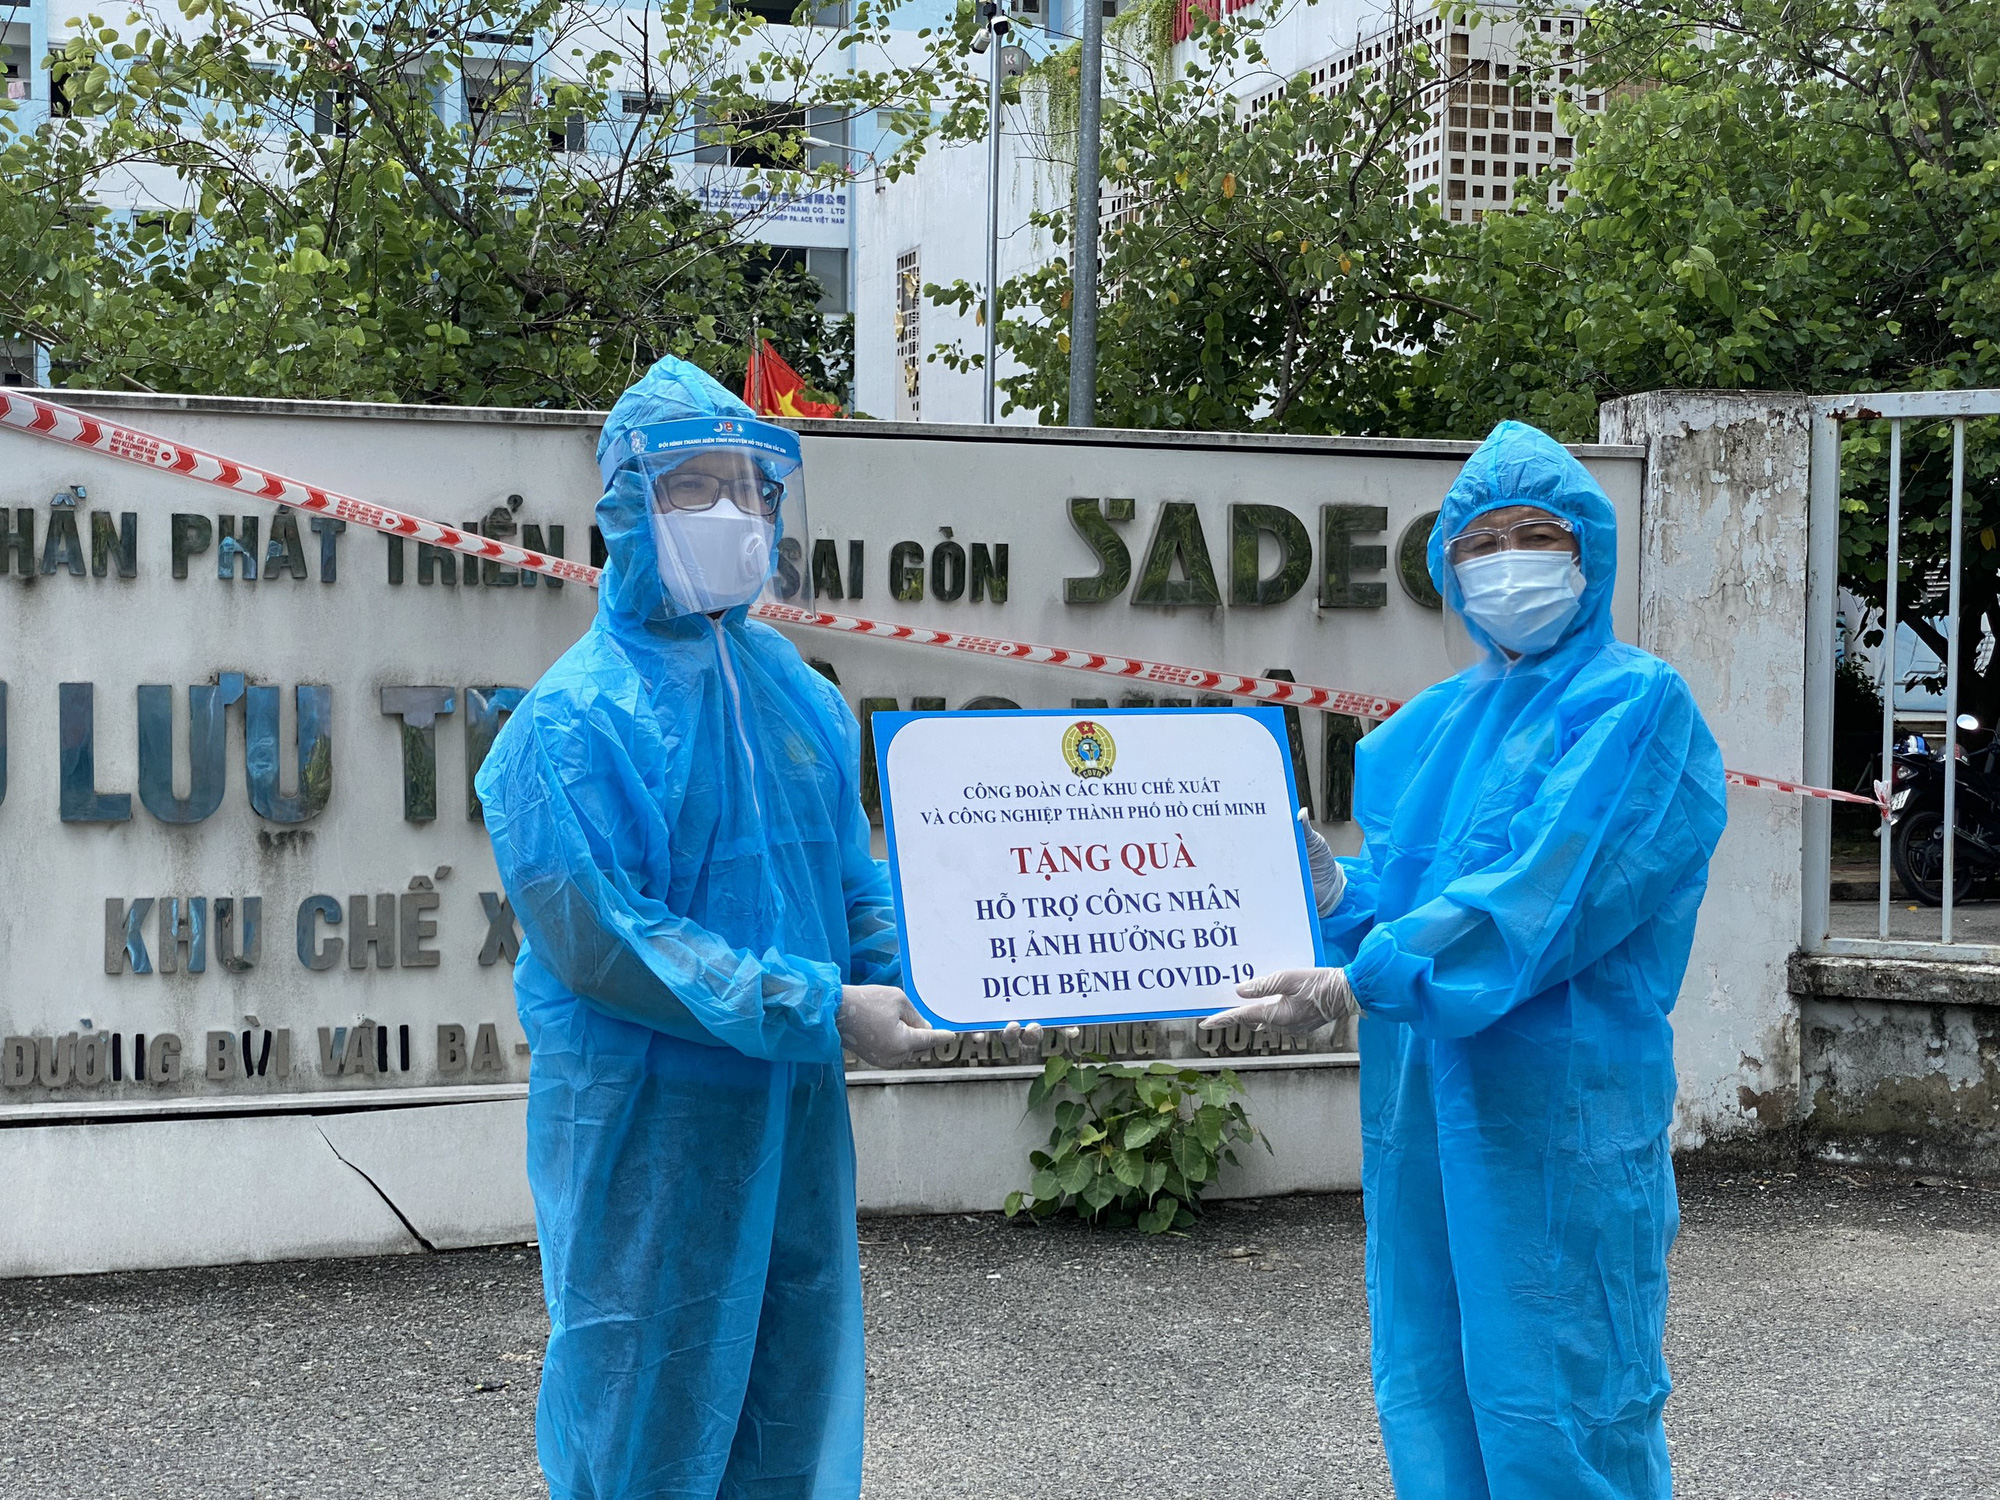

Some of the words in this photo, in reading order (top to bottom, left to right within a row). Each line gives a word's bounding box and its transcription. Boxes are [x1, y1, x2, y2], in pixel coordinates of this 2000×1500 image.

[171, 503, 347, 583] PHÁT
[889, 526, 1010, 603] GÒN
[59, 672, 332, 824] LƯU
[963, 782, 1011, 799] CÔNG
[1015, 781, 1061, 798] ĐOÀN
[1065, 780, 1099, 797] CÁC
[1103, 782, 1137, 796] KHU
[1142, 778, 1175, 794] CHẾ
[1179, 777, 1221, 794] XUẤT
[920, 808, 945, 825] VÀ
[948, 807, 996, 825] CÔNG
[1000, 806, 1063, 824] NGHIỆP
[1066, 804, 1124, 821] THÀNH
[1128, 802, 1161, 819] PHỐ
[1165, 800, 1188, 817] HỒ
[1192, 800, 1221, 816] CHÍ
[1224, 802, 1266, 816] MINH
[1010, 841, 1111, 881] TẶNG
[1120, 833, 1197, 876] QUÀ
[105, 897, 262, 974] KHU
[297, 865, 452, 971] CHẾ
[975, 892, 1016, 920] HỖ
[1022, 893, 1078, 922] TRỢ
[1085, 887, 1162, 916] CÔNG
[1167, 883, 1241, 912] NHÂN
[989, 937, 1018, 963] BỊ
[1025, 930, 1080, 957] ẢNH
[1088, 925, 1186, 954] HƯỞNG
[1191, 921, 1239, 949] BỞI
[981, 974, 1050, 1002] DỊCH
[1057, 968, 1132, 998] BỆNH
[1137, 963, 1255, 990] COVID-19
